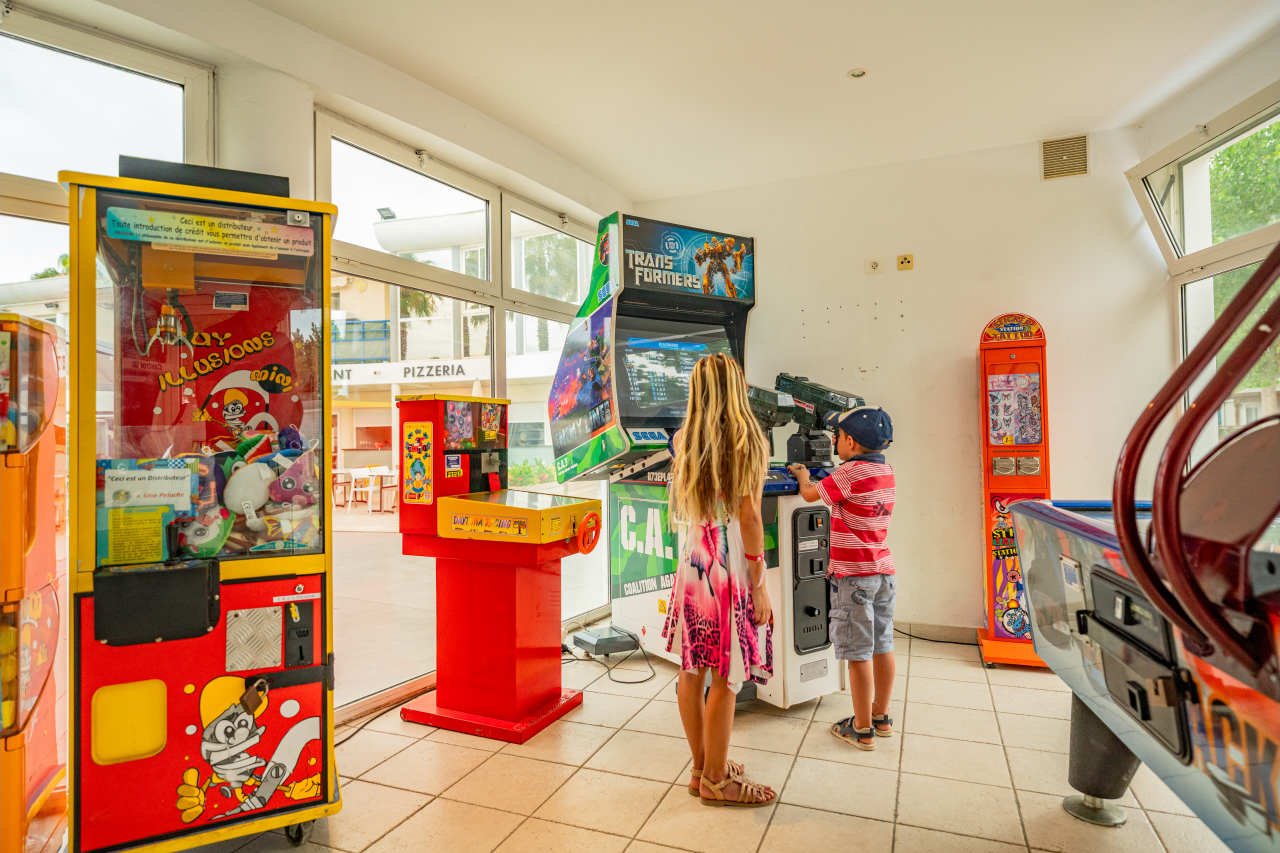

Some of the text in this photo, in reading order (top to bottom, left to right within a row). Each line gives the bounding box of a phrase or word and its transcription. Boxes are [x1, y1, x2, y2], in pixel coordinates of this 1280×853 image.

[133, 223, 172, 233] introduction
[222, 231, 253, 242] permettra
[180, 217, 193, 225] Ceci
[218, 221, 253, 232] distributeur
[624, 248, 674, 270] TRANS
[635, 266, 701, 289] FORMERS
[158, 331, 275, 392] ILLUSIONS
[403, 364, 466, 378] PIZZERIA
[632, 431, 667, 441] SEGA
[624, 577, 657, 596] COALITION
